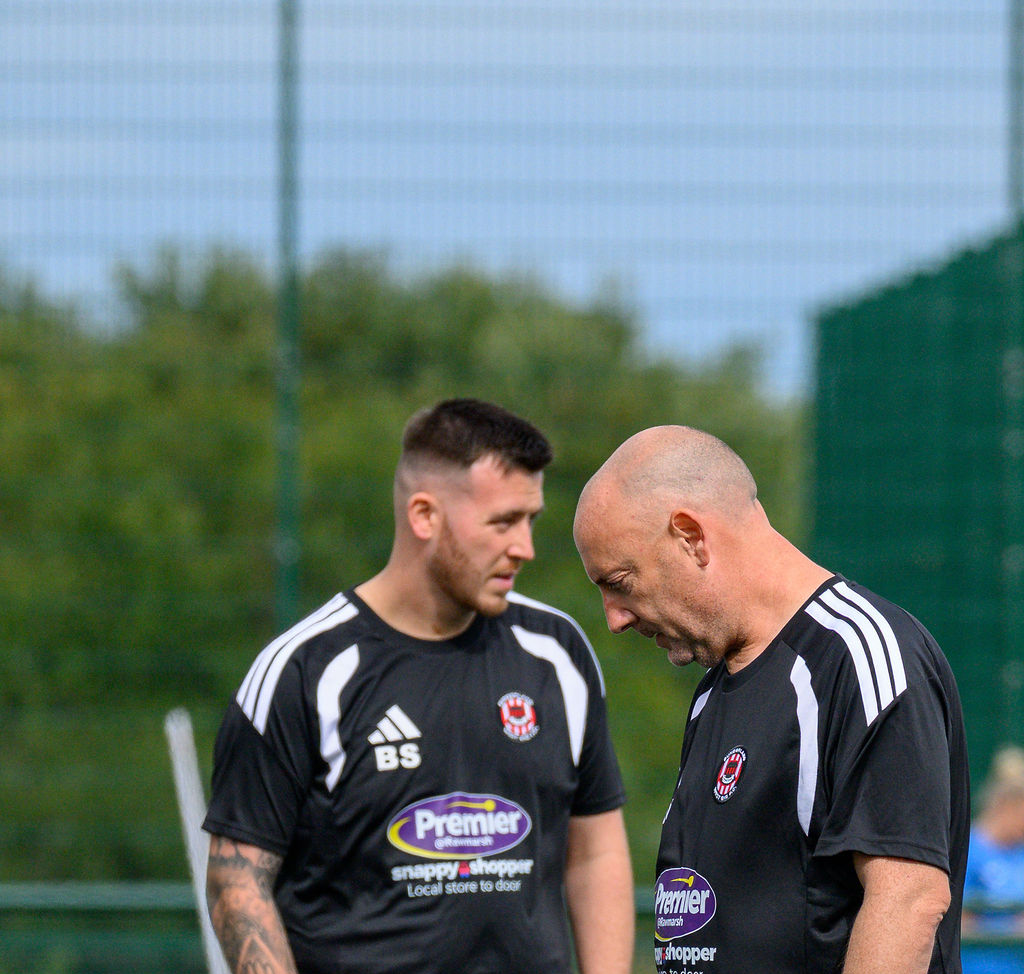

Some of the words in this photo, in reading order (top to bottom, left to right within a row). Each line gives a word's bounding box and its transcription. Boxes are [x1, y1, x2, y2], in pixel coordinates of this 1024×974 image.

[375, 743, 421, 771] BS
[414, 809, 522, 839] Premier
[391, 861, 459, 881] snappy
[469, 857, 534, 877] shopper
[407, 882, 443, 897] Local
[445, 881, 478, 894] store
[480, 880, 494, 892] to
[495, 879, 521, 891] door
[655, 883, 710, 914] Premier
[665, 942, 716, 965] shopper
